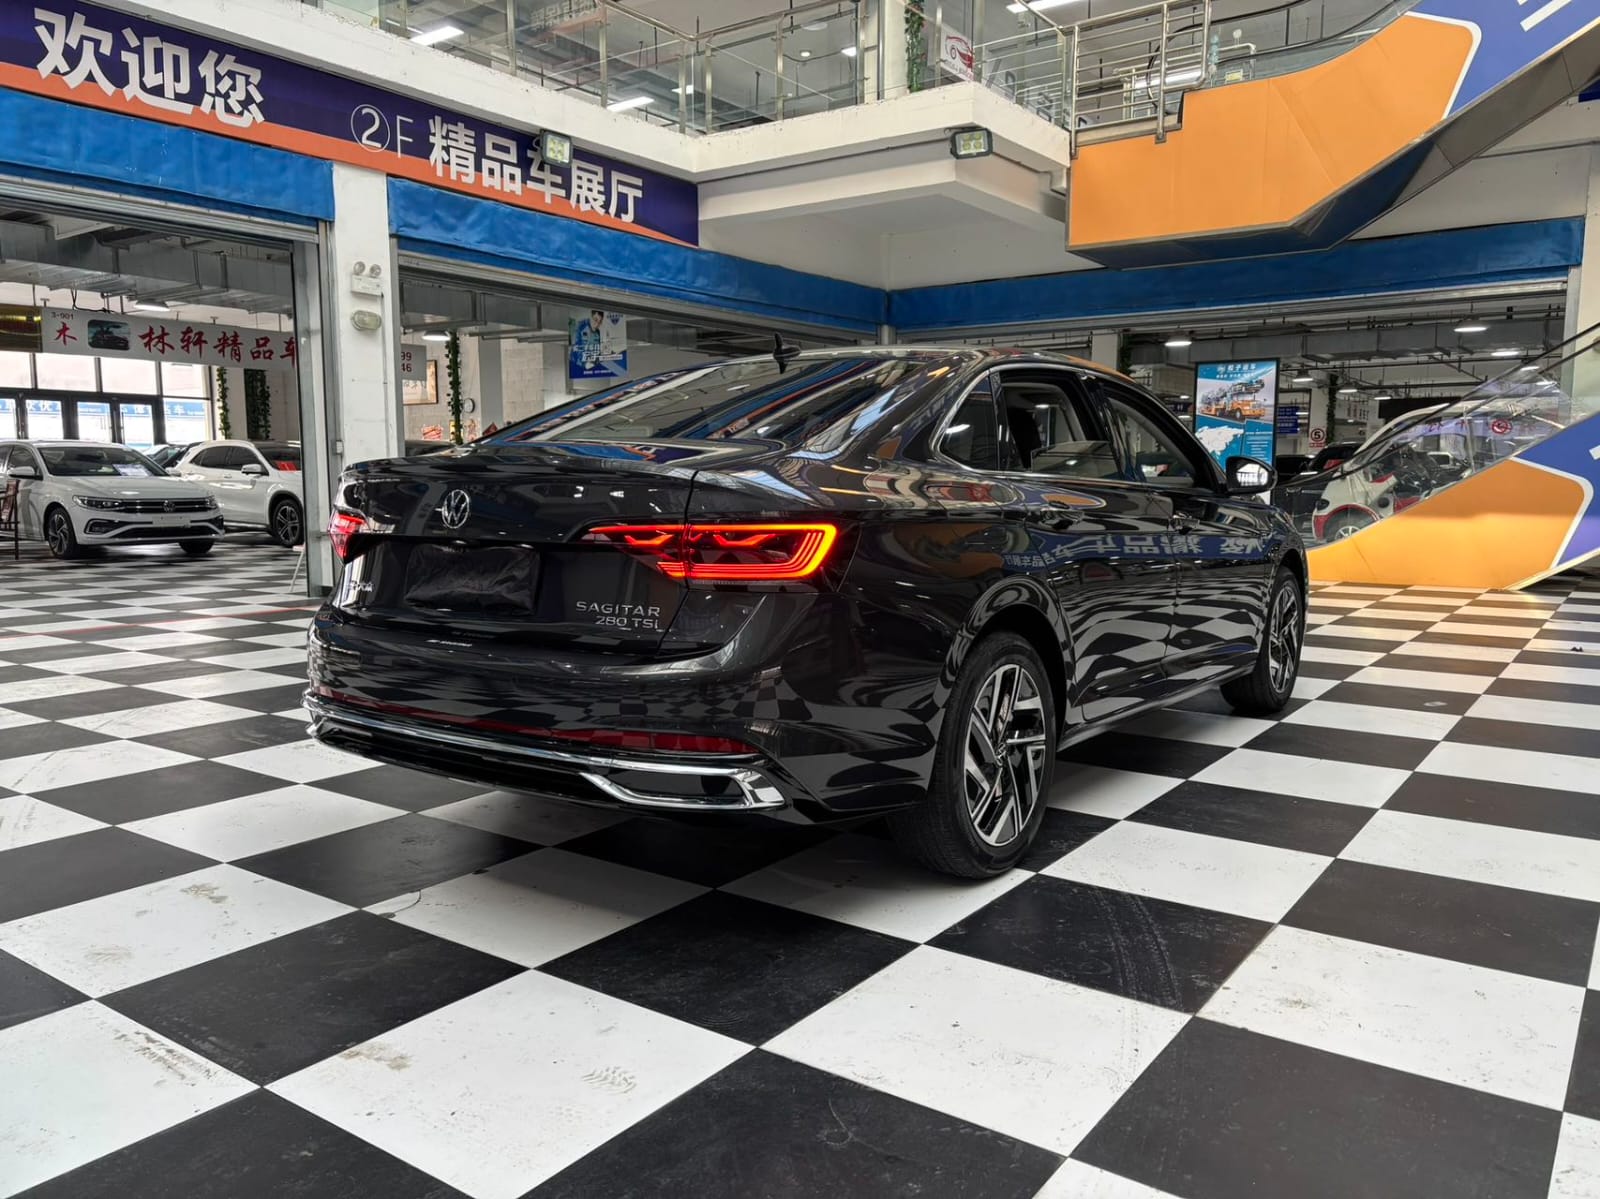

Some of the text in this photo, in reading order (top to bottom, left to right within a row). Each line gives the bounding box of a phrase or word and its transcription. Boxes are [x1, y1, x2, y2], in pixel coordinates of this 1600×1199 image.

[33, 7, 265, 129] 欢迎您
[428, 114, 644, 224] 精品车展厅
[575, 600, 661, 617] SAGITAR
[595, 615, 659, 629] 280 TSI
